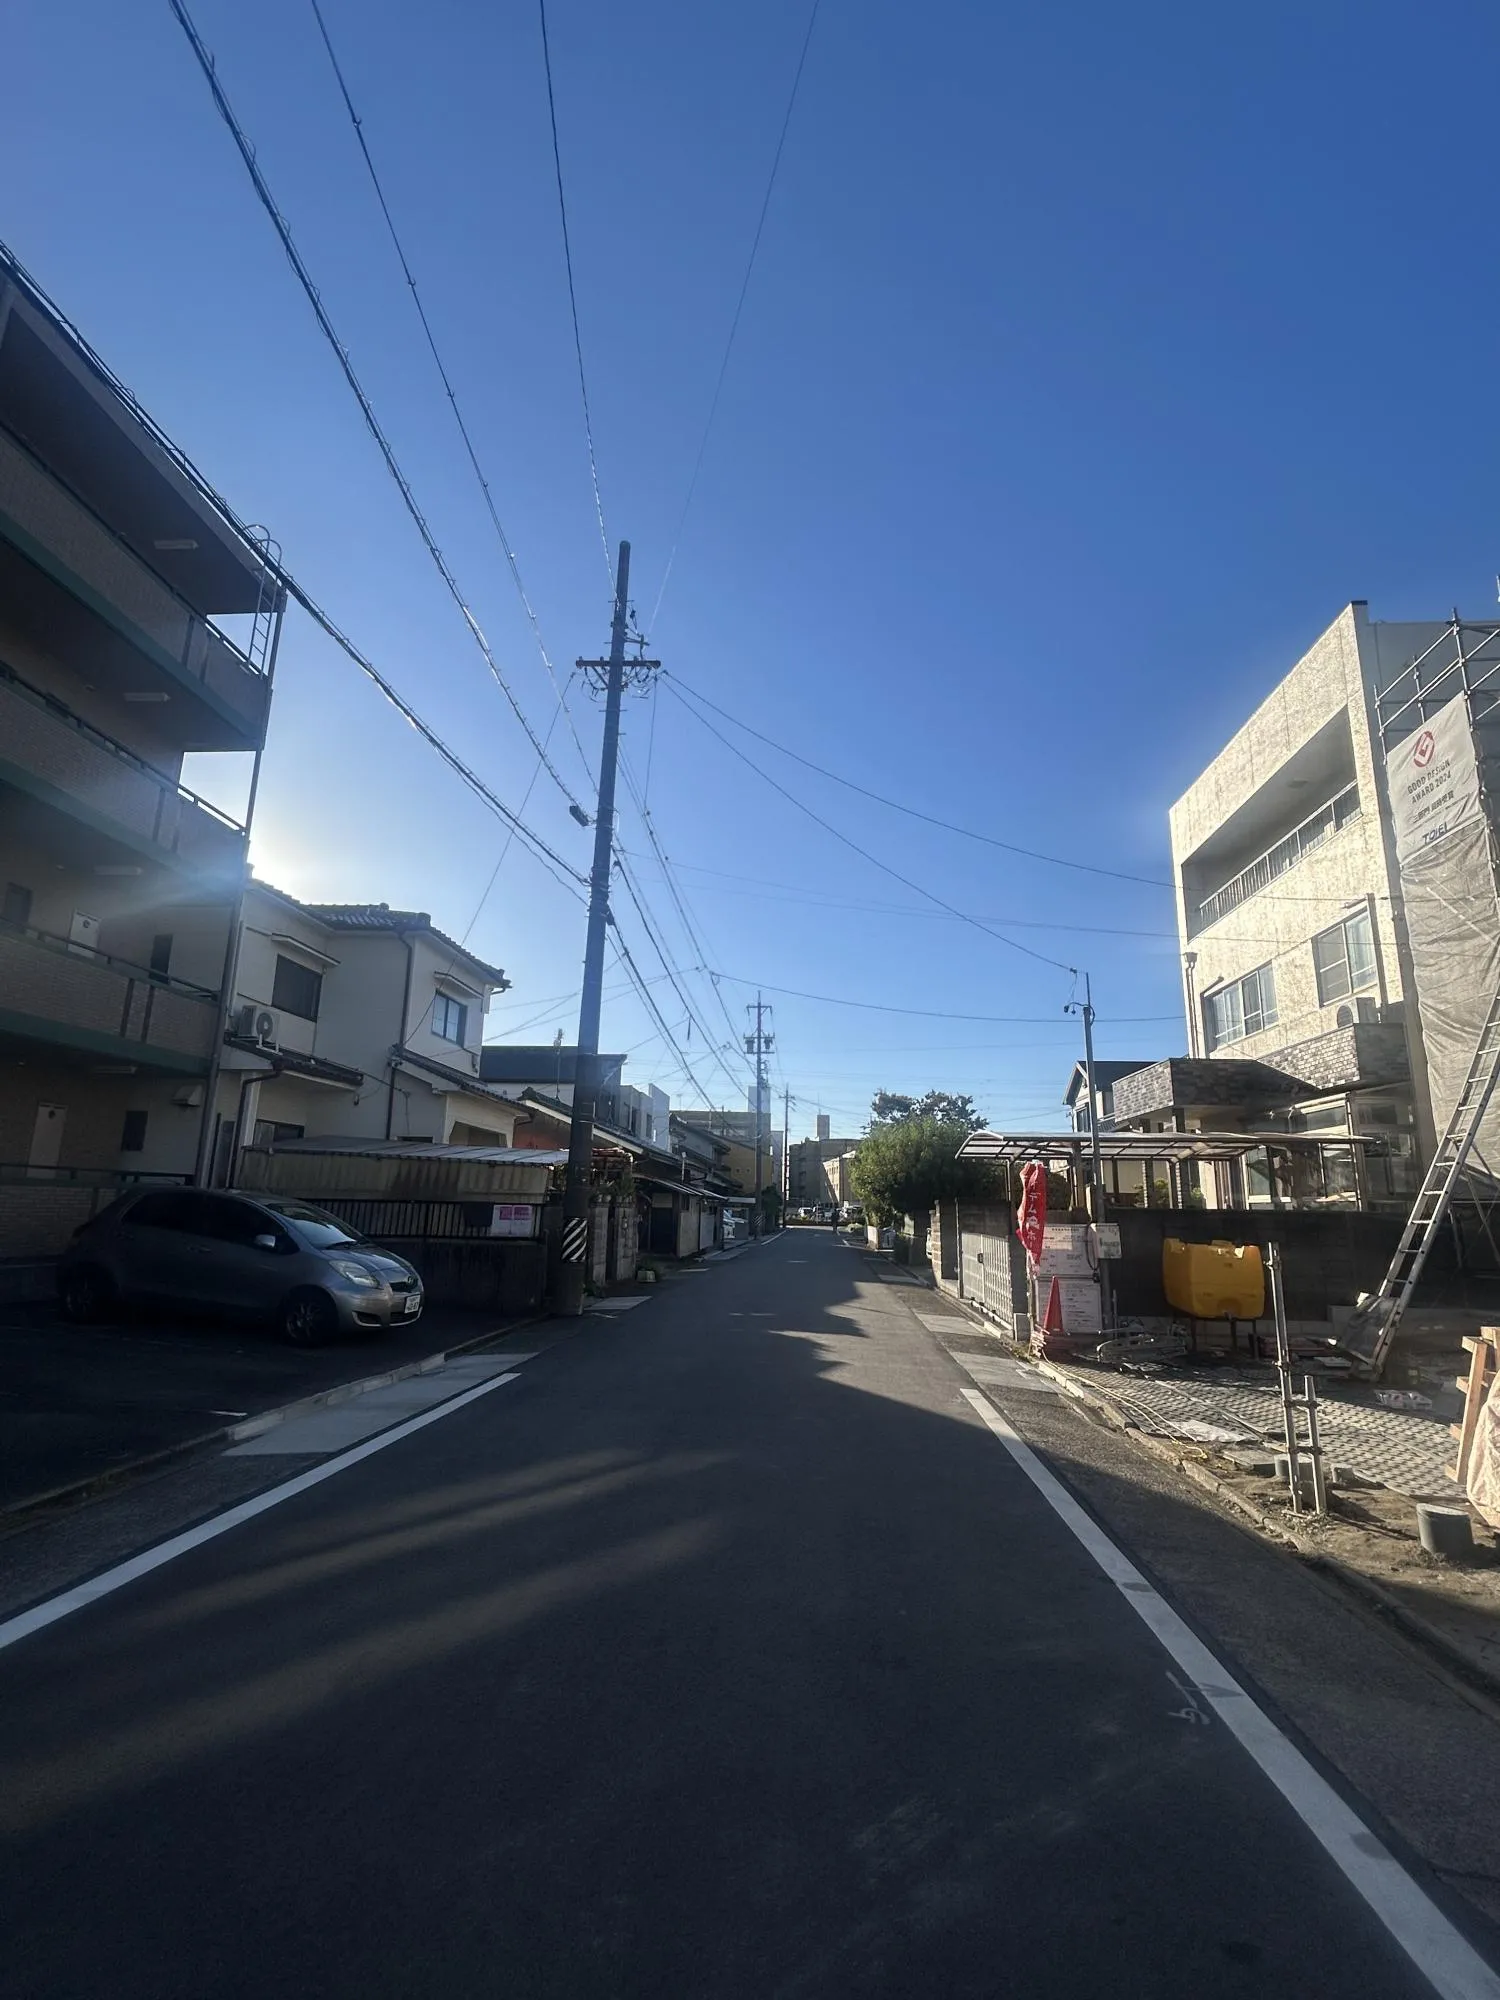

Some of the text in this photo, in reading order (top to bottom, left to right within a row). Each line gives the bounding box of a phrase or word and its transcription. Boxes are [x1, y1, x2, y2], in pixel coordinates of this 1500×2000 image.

[1407, 759, 1450, 794] GOOD DESIGN
[1412, 782, 1434, 803] AWARD
[1435, 770, 1451, 787] 2024
